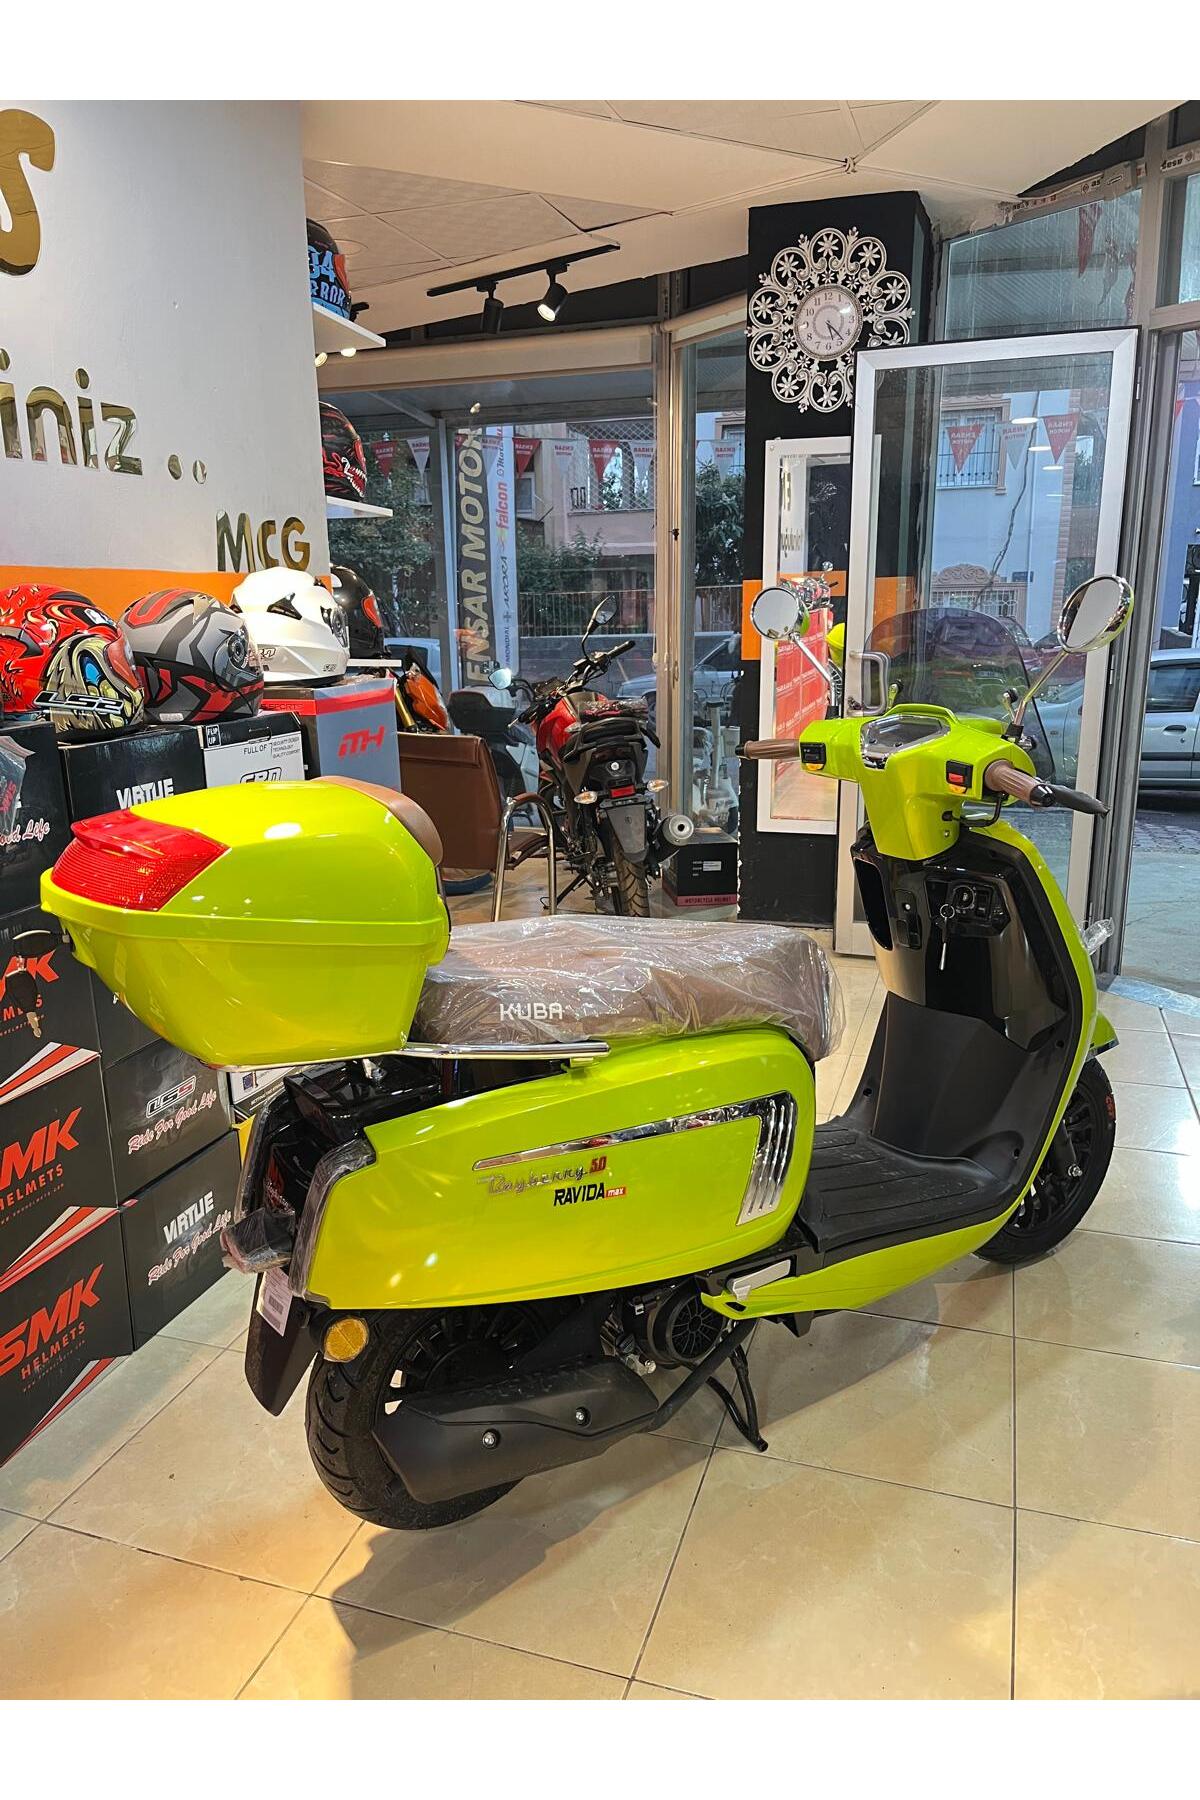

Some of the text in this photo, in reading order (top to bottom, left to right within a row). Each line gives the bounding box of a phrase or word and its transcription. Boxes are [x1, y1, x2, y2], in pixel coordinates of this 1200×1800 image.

[495, 482, 510, 530] falcon
[458, 427, 492, 684] ENSAR MOTOR
[33, 690, 124, 715] LS2
[243, 744, 267, 755] FULL OF
[115, 777, 175, 811] VIRTUE
[499, 1001, 564, 1021] KUBA
[127, 1129, 155, 1155] Ride
[174, 1099, 198, 1130] Good
[197, 1088, 217, 1109] Life
[162, 1190, 215, 1245] VIRTUE
[553, 1182, 625, 1207] RAVIDA max
[147, 1257, 173, 1287] Ride
[190, 1222, 213, 1255] Good
[0, 1263, 104, 1378] SMK
[21, 1320, 87, 1381] HELMETS
